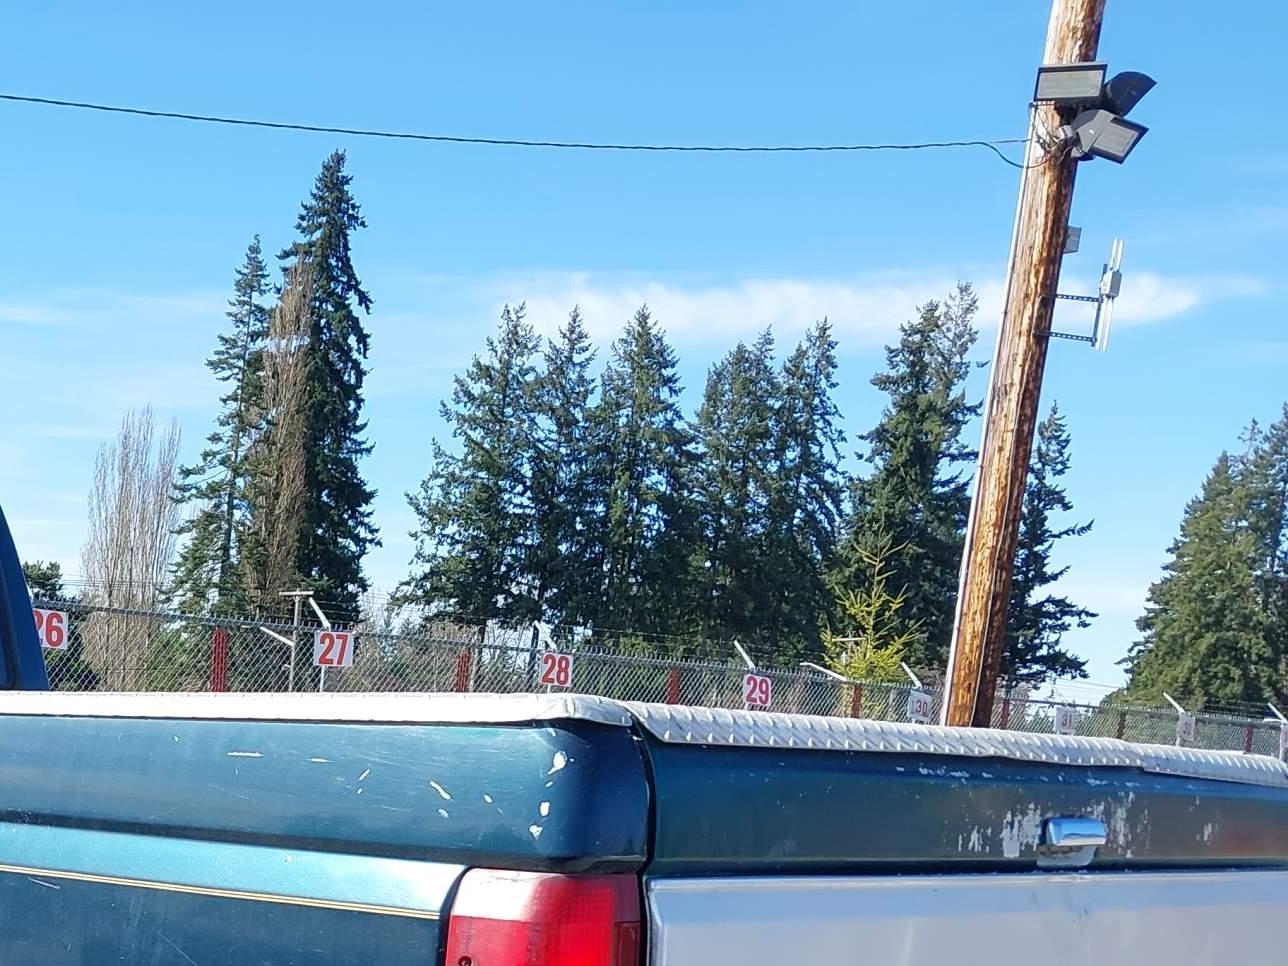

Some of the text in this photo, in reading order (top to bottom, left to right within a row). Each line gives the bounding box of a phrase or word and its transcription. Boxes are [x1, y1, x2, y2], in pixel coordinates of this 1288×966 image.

[318, 632, 349, 665] 27
[541, 653, 570, 686] 28
[745, 675, 770, 706] 29
[915, 699, 929, 718] 30
